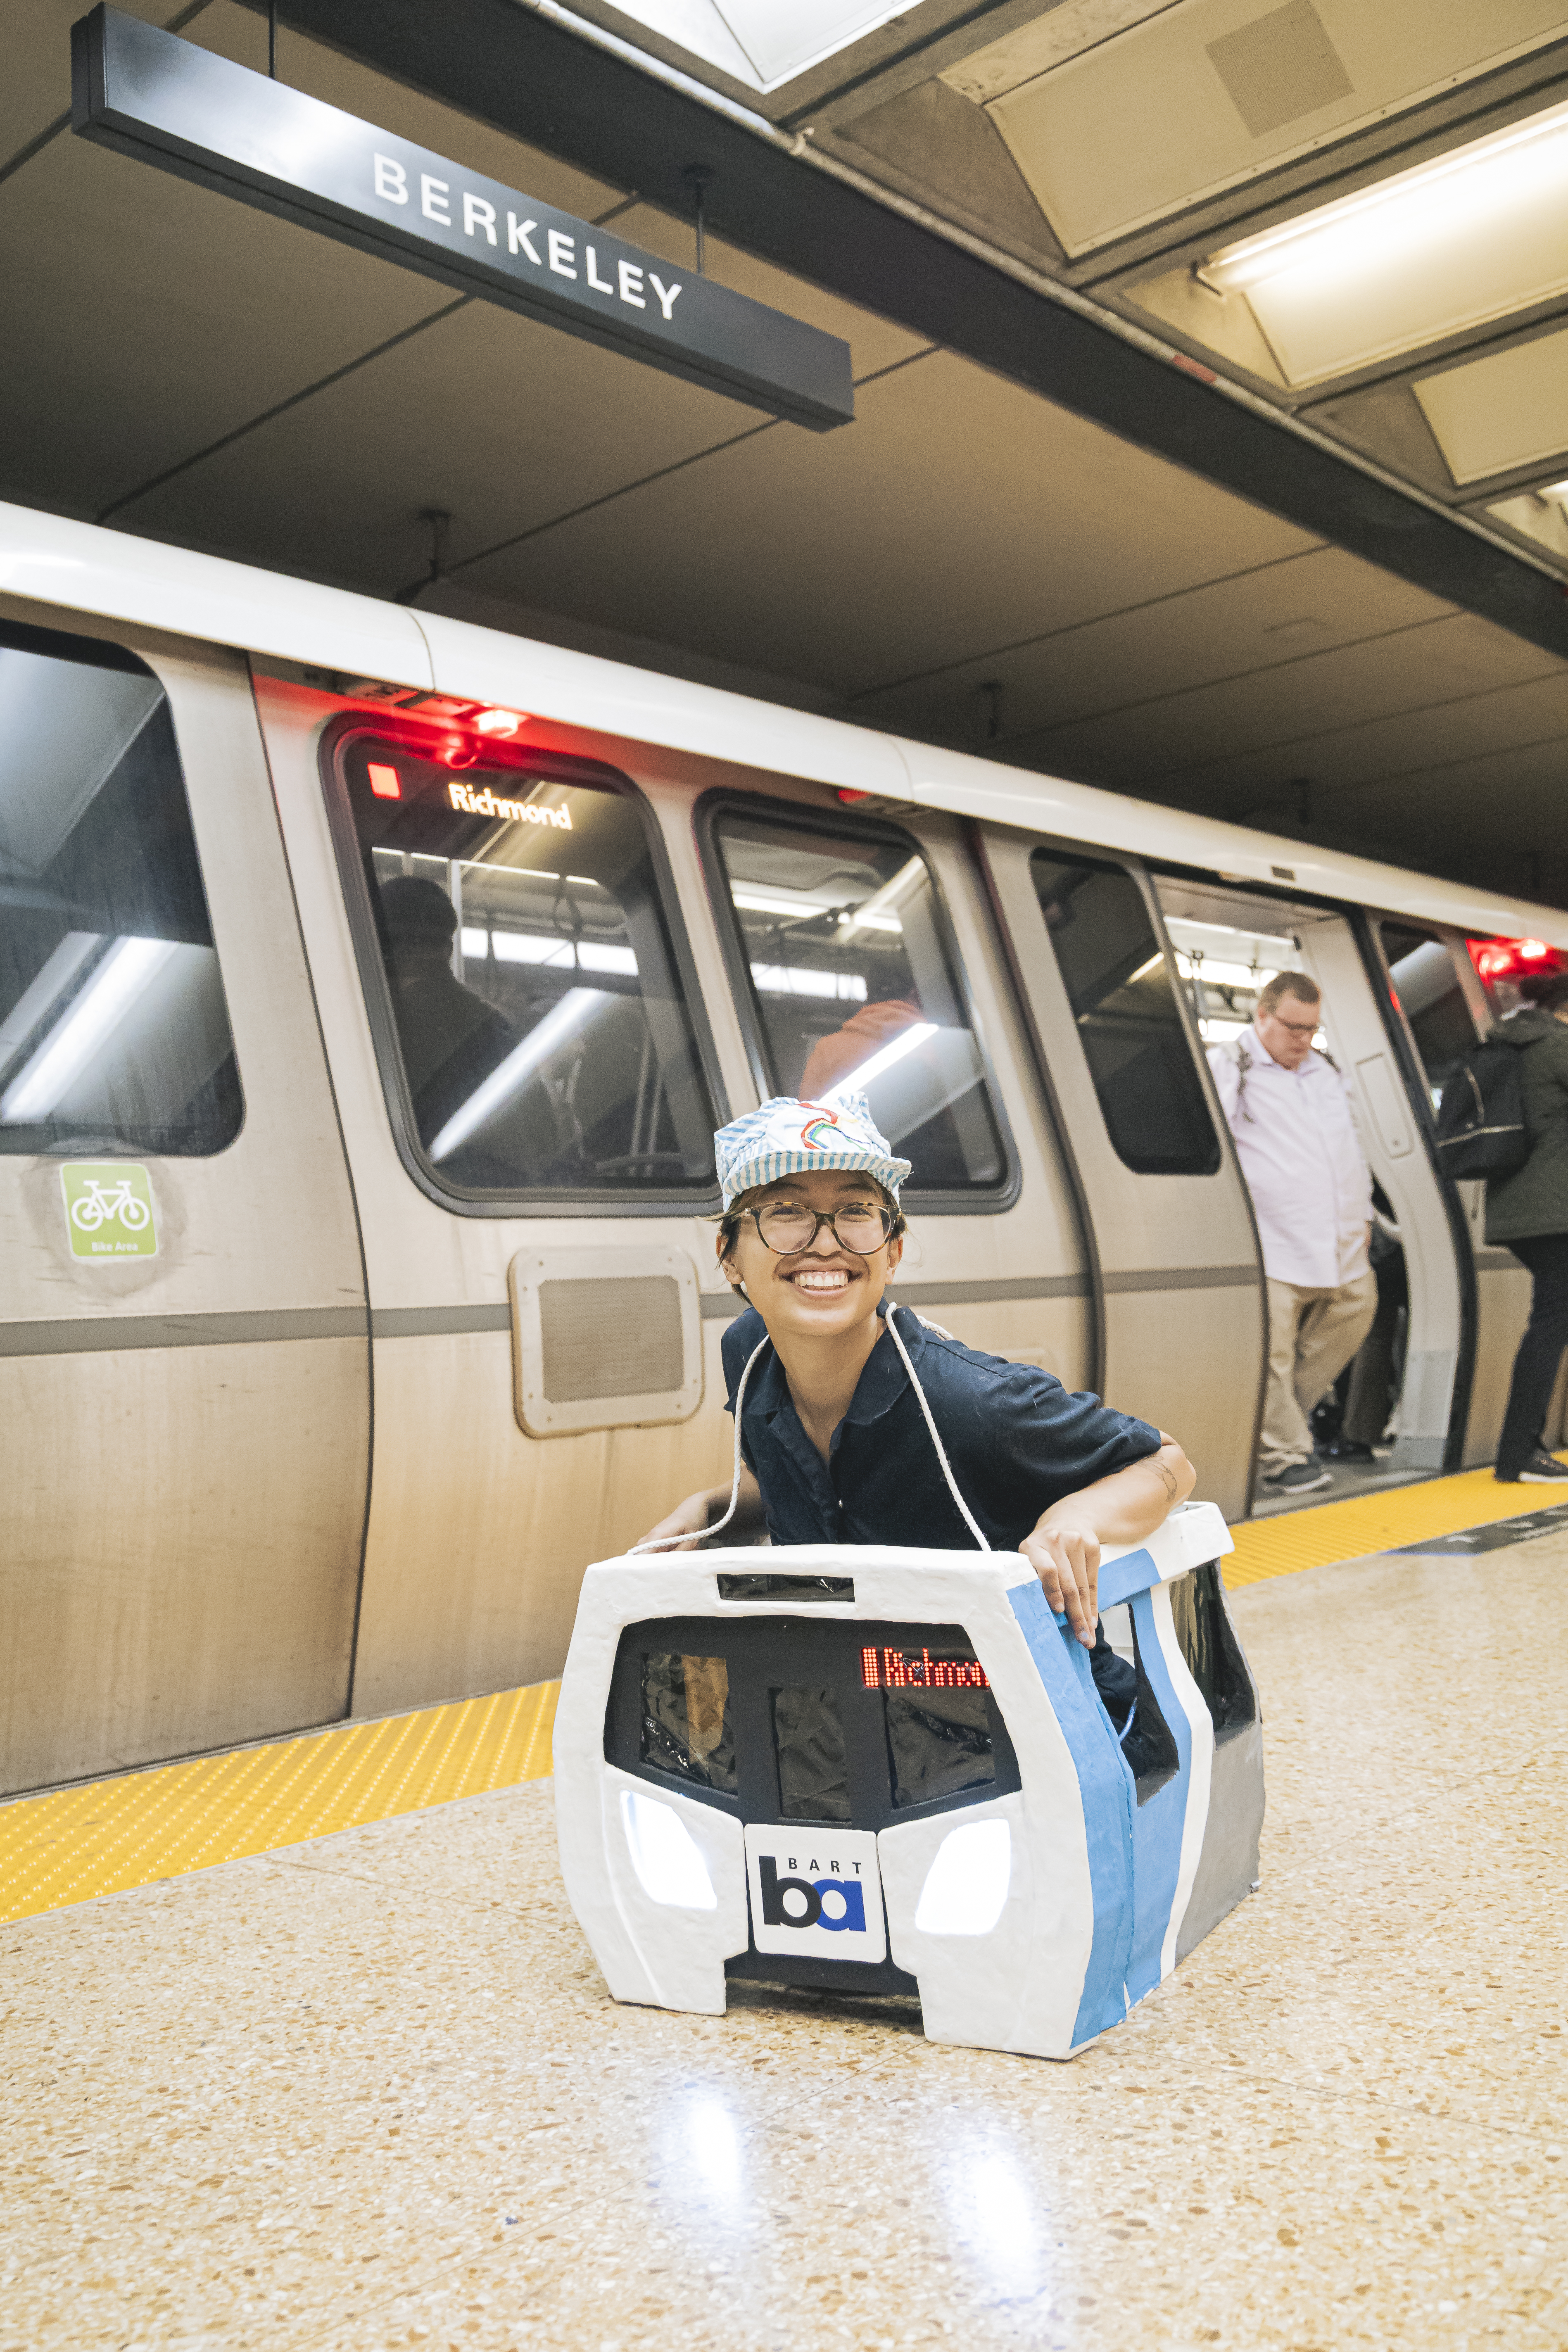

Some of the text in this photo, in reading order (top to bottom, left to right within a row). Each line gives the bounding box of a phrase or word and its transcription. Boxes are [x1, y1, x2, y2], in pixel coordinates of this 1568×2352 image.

[374, 152, 682, 320] BERKELEY
[448, 783, 573, 830] Richmond
[91, 1241, 139, 1252] Bike Area
[788, 1858, 862, 1874] BART
[758, 1855, 867, 1932] ba
